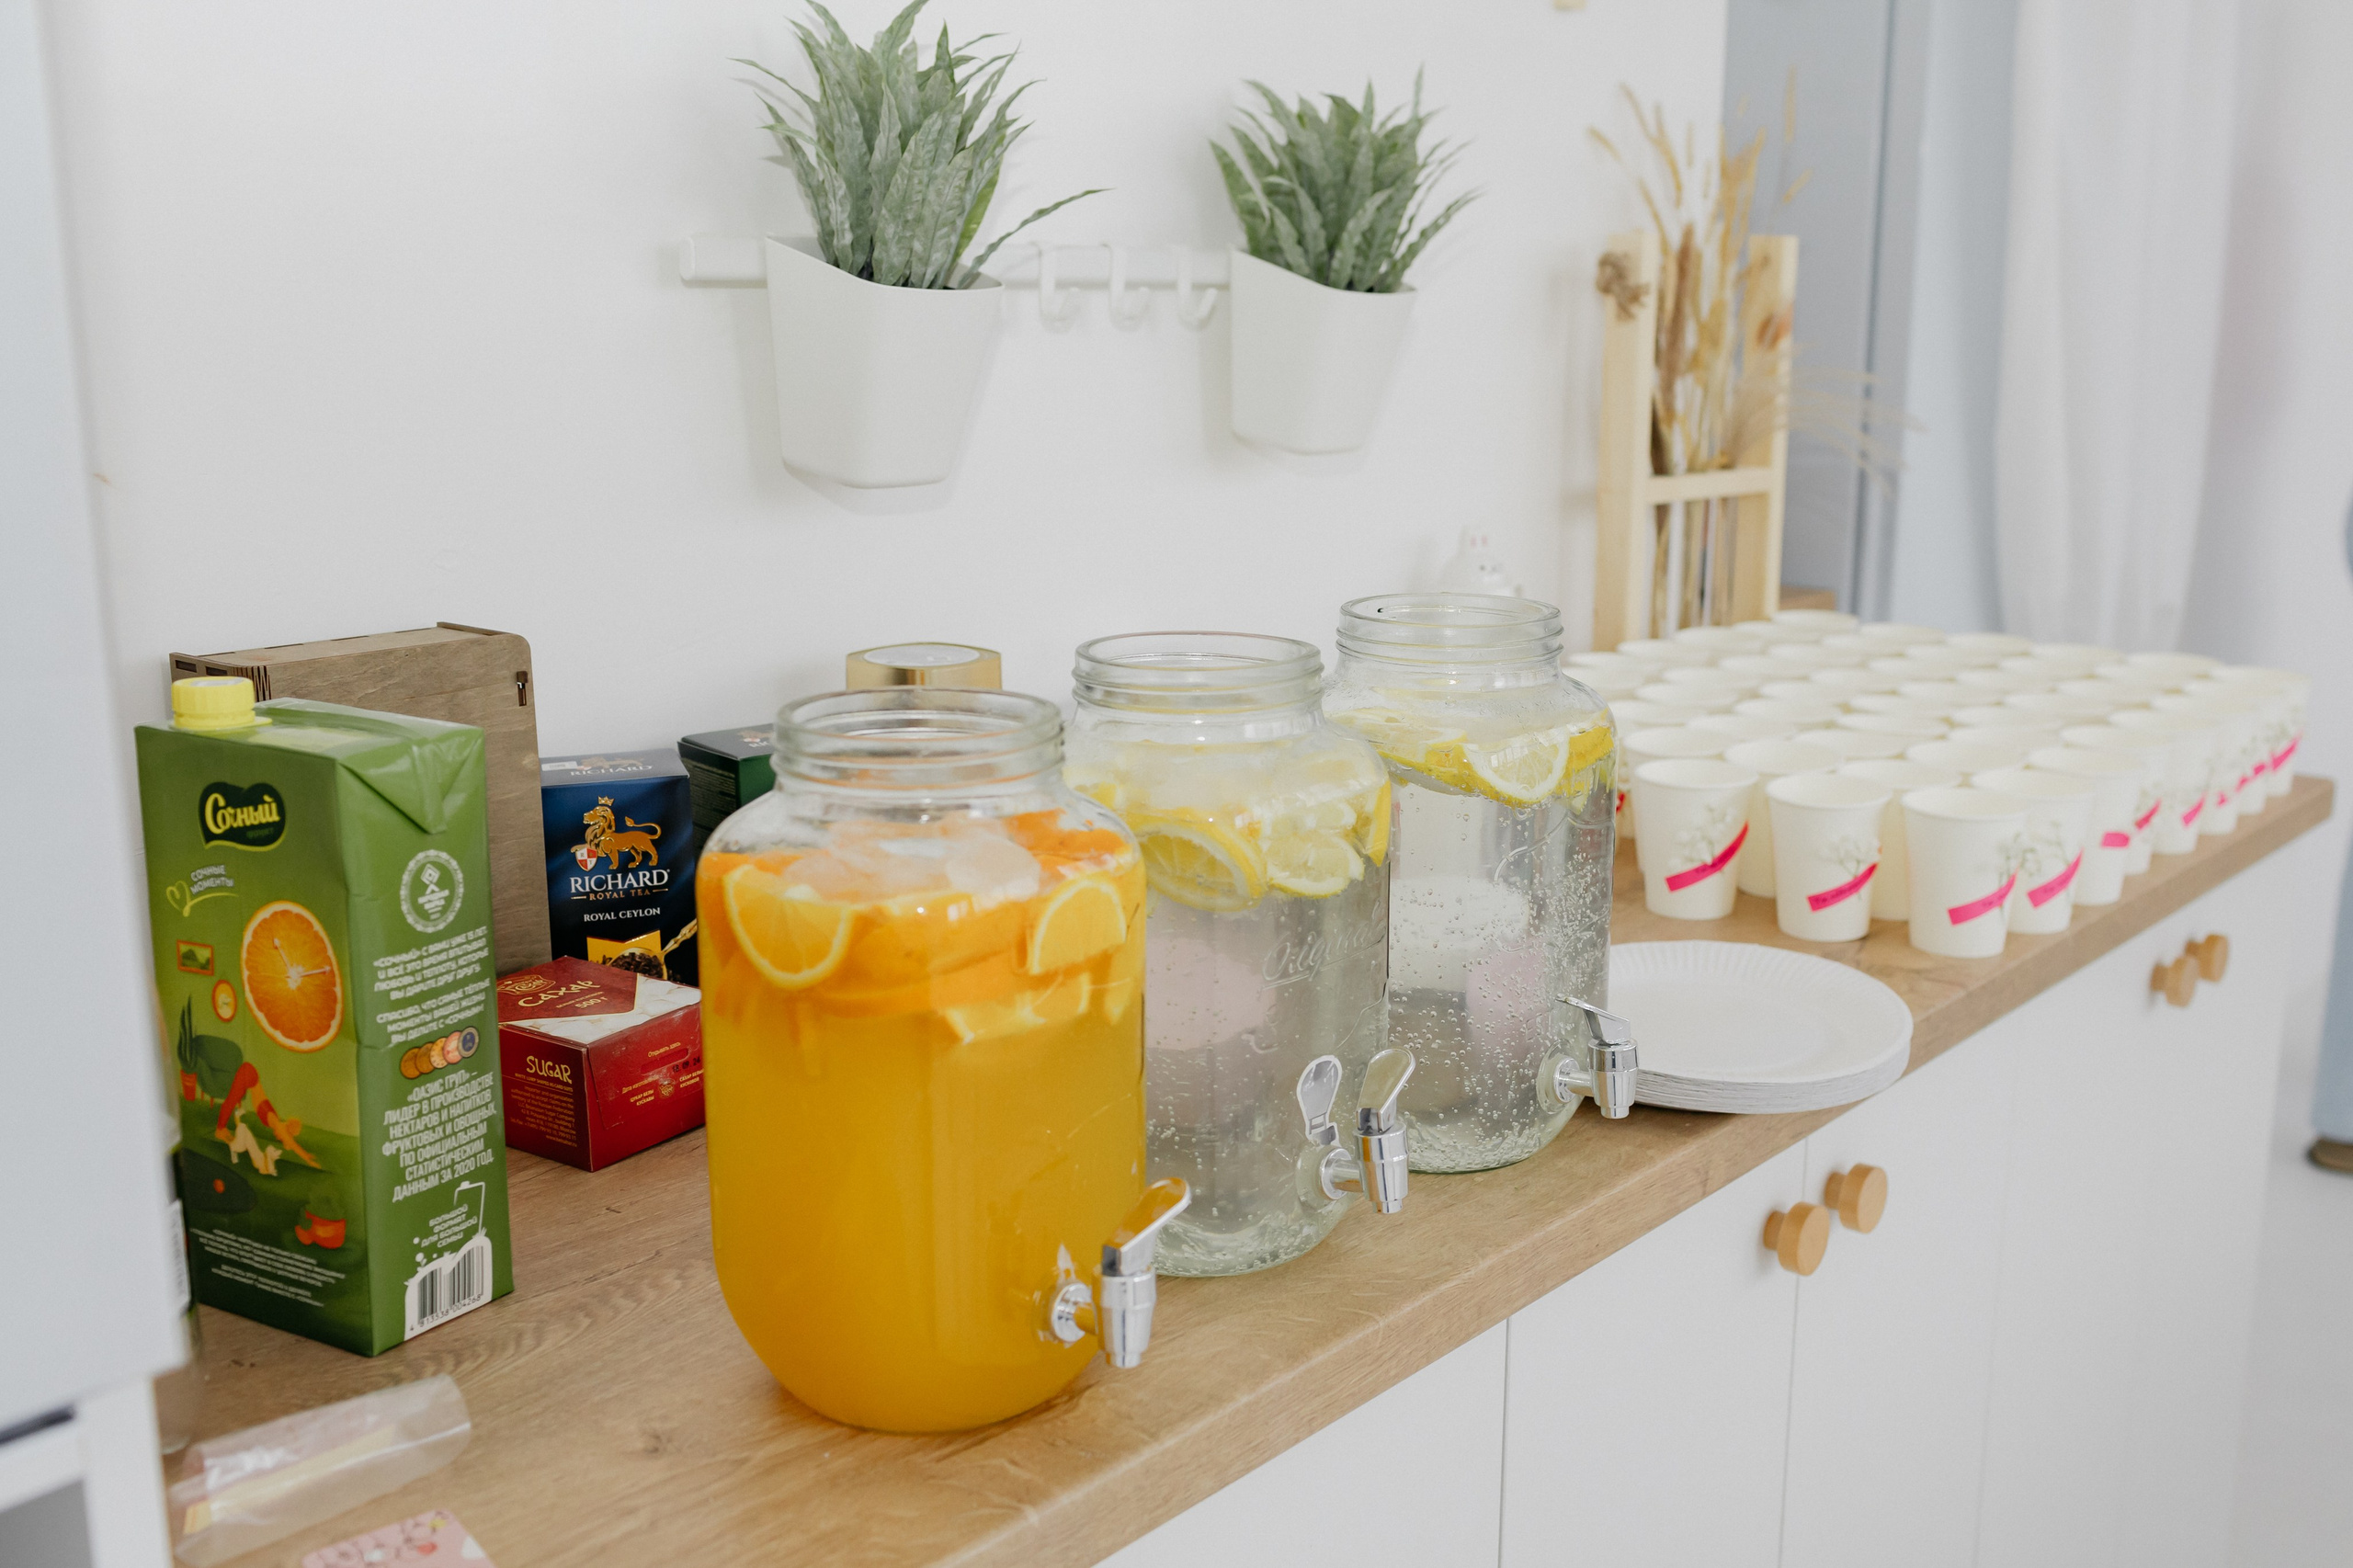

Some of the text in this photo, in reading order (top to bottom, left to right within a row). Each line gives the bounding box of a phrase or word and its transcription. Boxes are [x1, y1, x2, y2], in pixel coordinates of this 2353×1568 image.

[570, 765, 654, 776] RICHARD
[204, 792, 281, 835] Сочный
[189, 876, 235, 895] МОМЕНТЫ
[190, 864, 225, 881] СОЧНЫЕ
[570, 869, 669, 893] RICHARD
[589, 888, 651, 901] ROYAL TEA
[584, 907, 661, 922] ROYAL CEYLON
[574, 998, 601, 1008] 500
[526, 1055, 573, 1085] SUGAR
[383, 1072, 494, 1125] ЛИДЕР В ПРОИЗВОДСТВЕ
[389, 1088, 492, 1140] НЕКТАРОВ И НАПИТКОВ
[381, 1126, 445, 1156] ФРУКТОВЫХ
[445, 1122, 453, 1135] И
[400, 1152, 415, 1168] ПО
[416, 1120, 488, 1163] ОФИЦИАЛЬНЫМ
[405, 1137, 485, 1181] СТАТИСТИЧЕСКИМ
[392, 1172, 439, 1203] ДАННЫМ
[440, 1167, 452, 1184] ЗА
[453, 1157, 475, 1178] 2020
[428, 1203, 469, 1227] БОЛЬШОЙ
[433, 1213, 467, 1233] ФОРМАТ
[421, 1216, 478, 1248] ДЛЯ БОЛЬШОЙ
